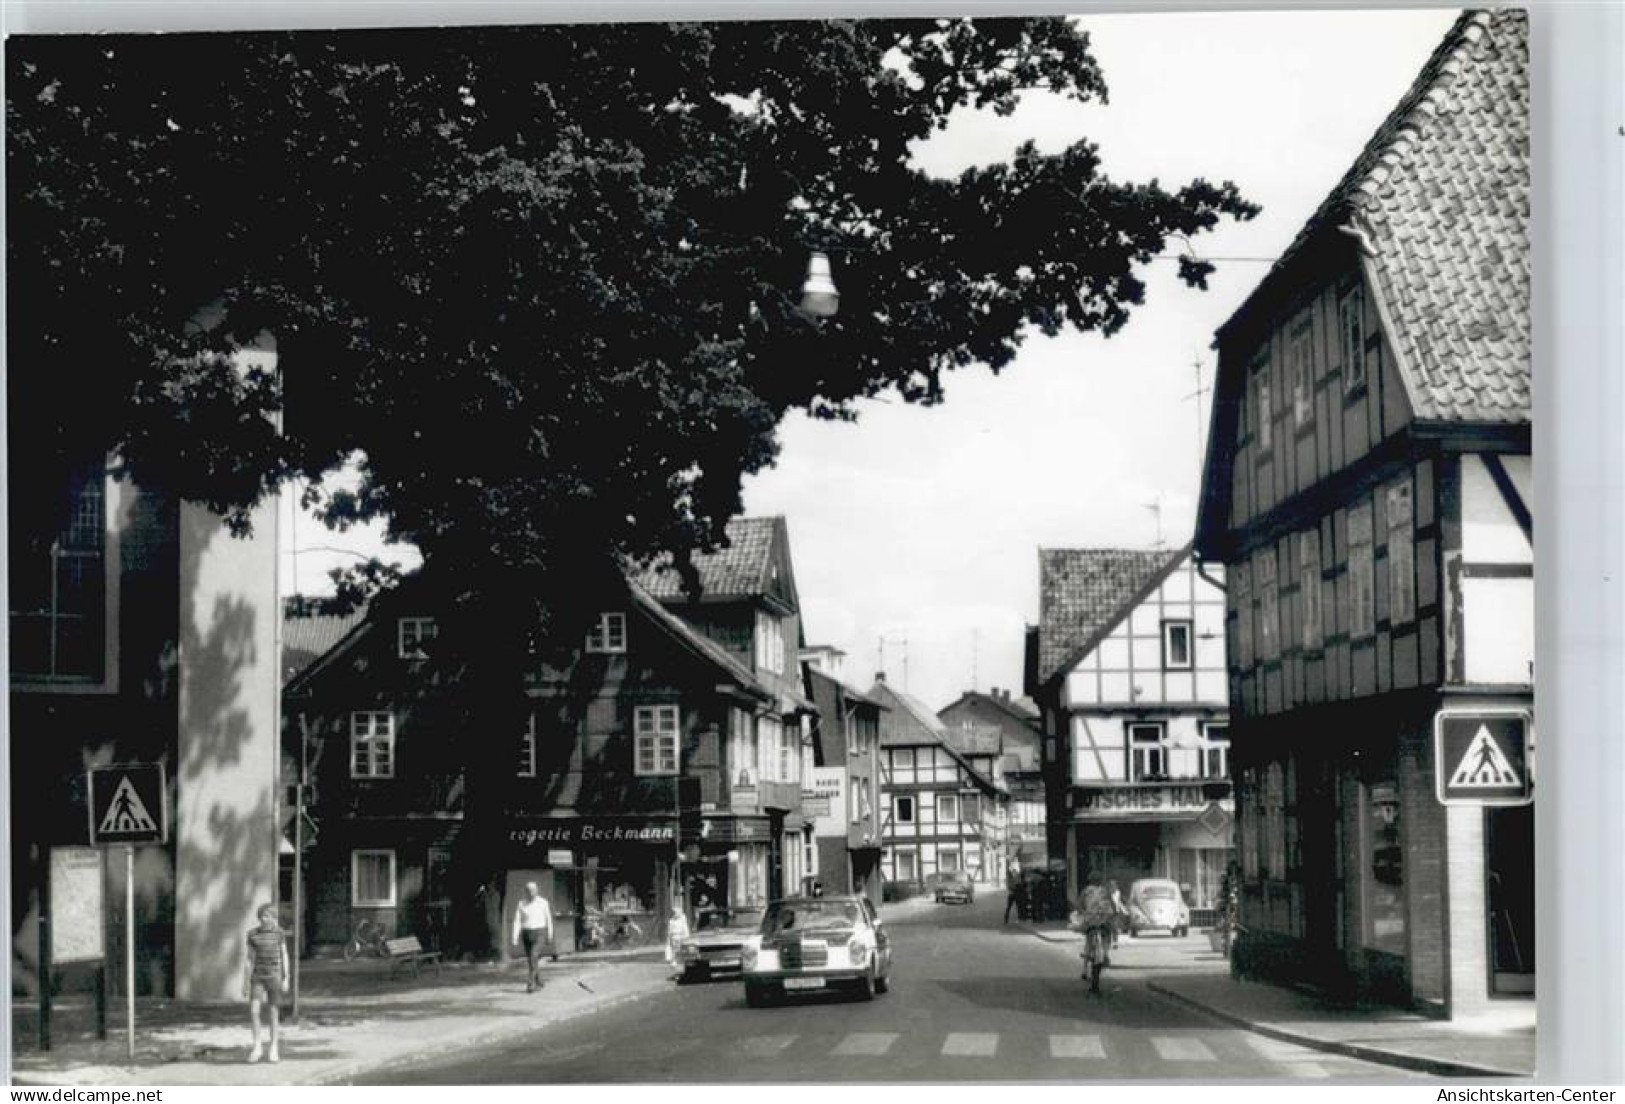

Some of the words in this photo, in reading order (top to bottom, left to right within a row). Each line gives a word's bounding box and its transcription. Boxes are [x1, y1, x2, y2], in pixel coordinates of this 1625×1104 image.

[1171, 786, 1204, 806] HAU
[509, 826, 571, 846] rogerie
[581, 825, 673, 840] Beckmann
